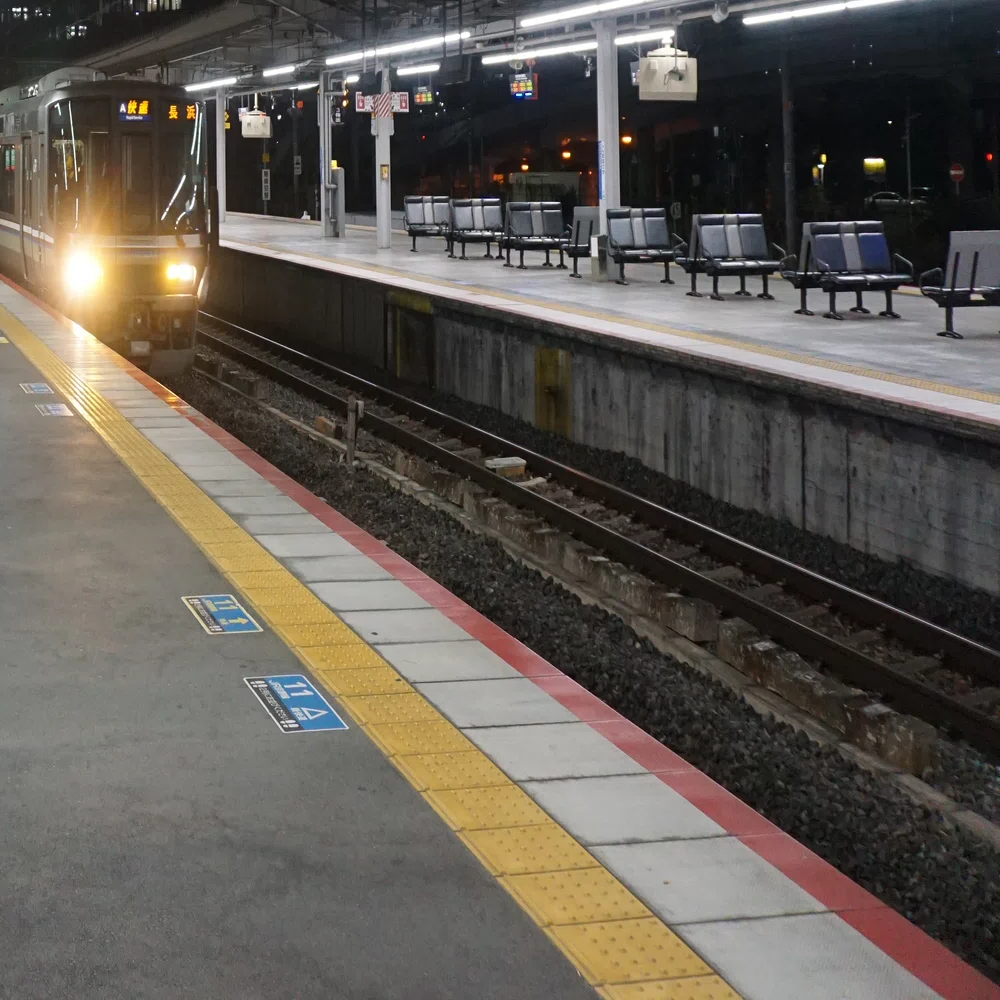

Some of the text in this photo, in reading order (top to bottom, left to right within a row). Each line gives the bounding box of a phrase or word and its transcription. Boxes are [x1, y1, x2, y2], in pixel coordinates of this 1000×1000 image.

[119, 100, 149, 115] A 快速
[168, 105, 196, 119] 長浜
[215, 599, 239, 611] 11
[284, 681, 315, 697] 11
